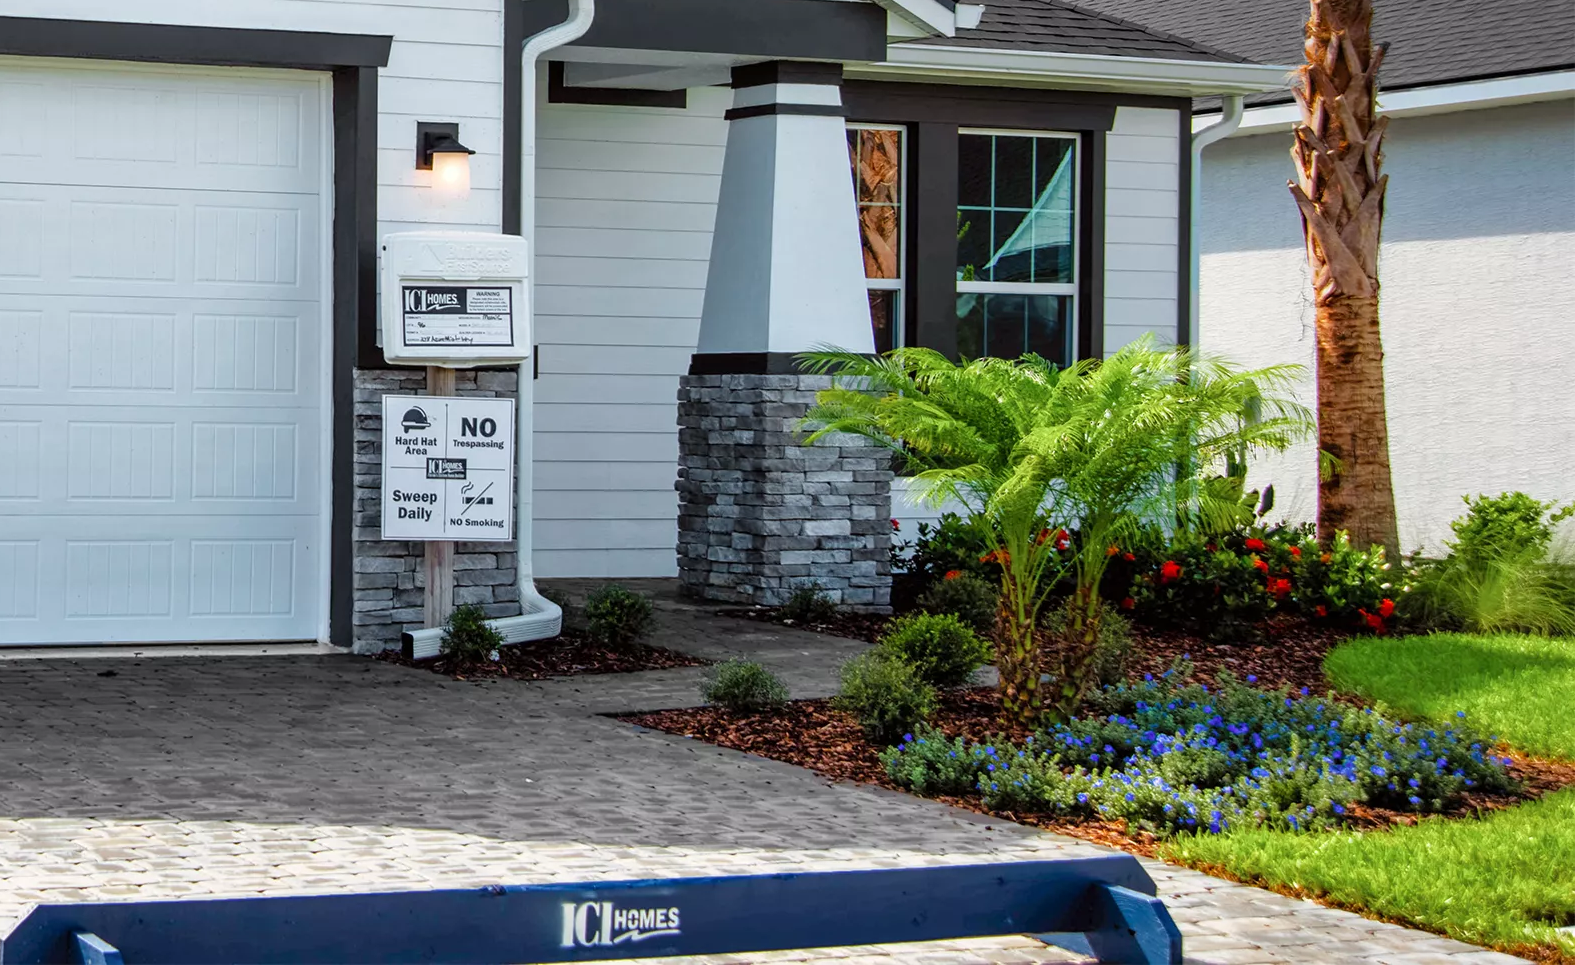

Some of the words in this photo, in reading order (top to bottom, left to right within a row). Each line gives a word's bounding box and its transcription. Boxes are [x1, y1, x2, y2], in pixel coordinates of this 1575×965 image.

[404, 289, 427, 312] ICI
[427, 293, 458, 304] HOMES
[461, 417, 497, 438] NO
[395, 437, 419, 446] Hard
[421, 437, 437, 446] Hat
[453, 440, 504, 450] Trespassing
[405, 446, 427, 455] Area
[428, 459, 442, 473] ICI
[392, 490, 437, 505] Sweep
[398, 507, 432, 522] Daily
[465, 519, 504, 528] Smoking
[561, 901, 613, 948] ICI
[614, 907, 680, 930] HOMES
